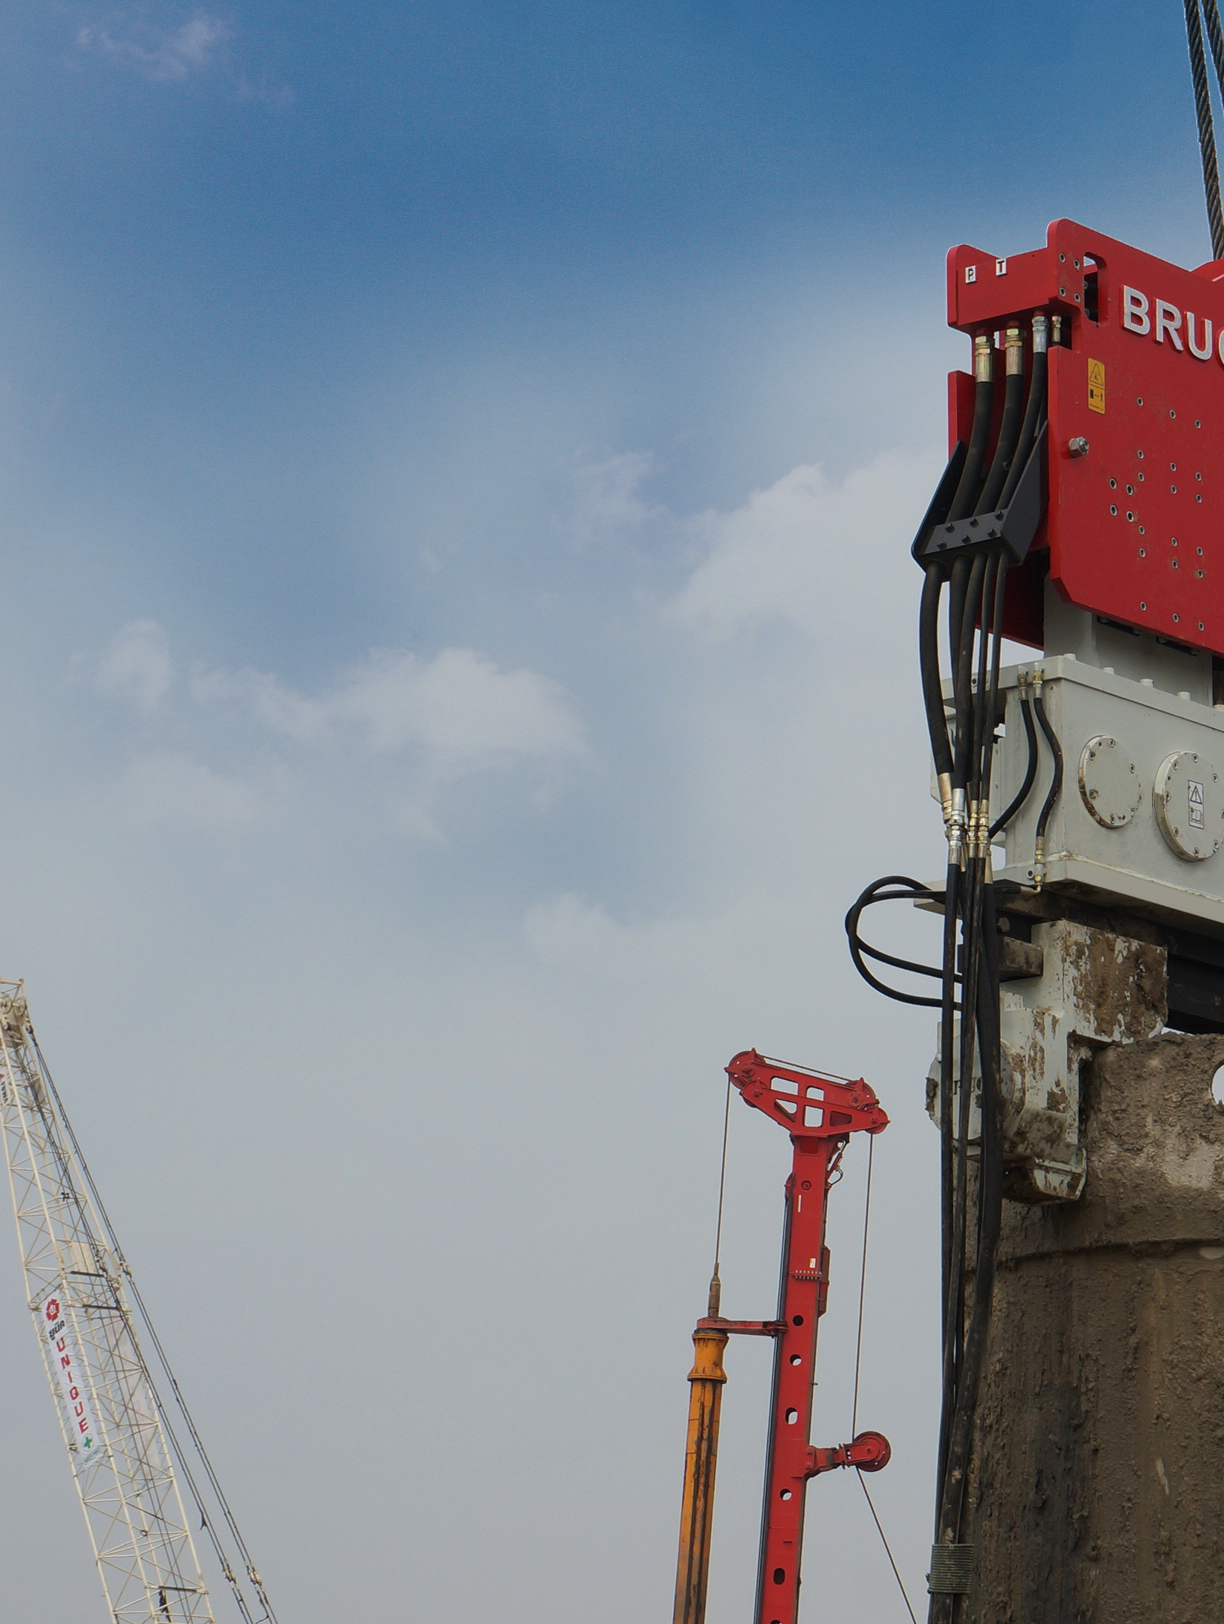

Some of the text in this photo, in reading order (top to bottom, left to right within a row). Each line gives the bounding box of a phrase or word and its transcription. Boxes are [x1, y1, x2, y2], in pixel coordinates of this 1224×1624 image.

[967, 259, 1005, 282] P T
[56, 1336, 90, 1434] UNIQUE
